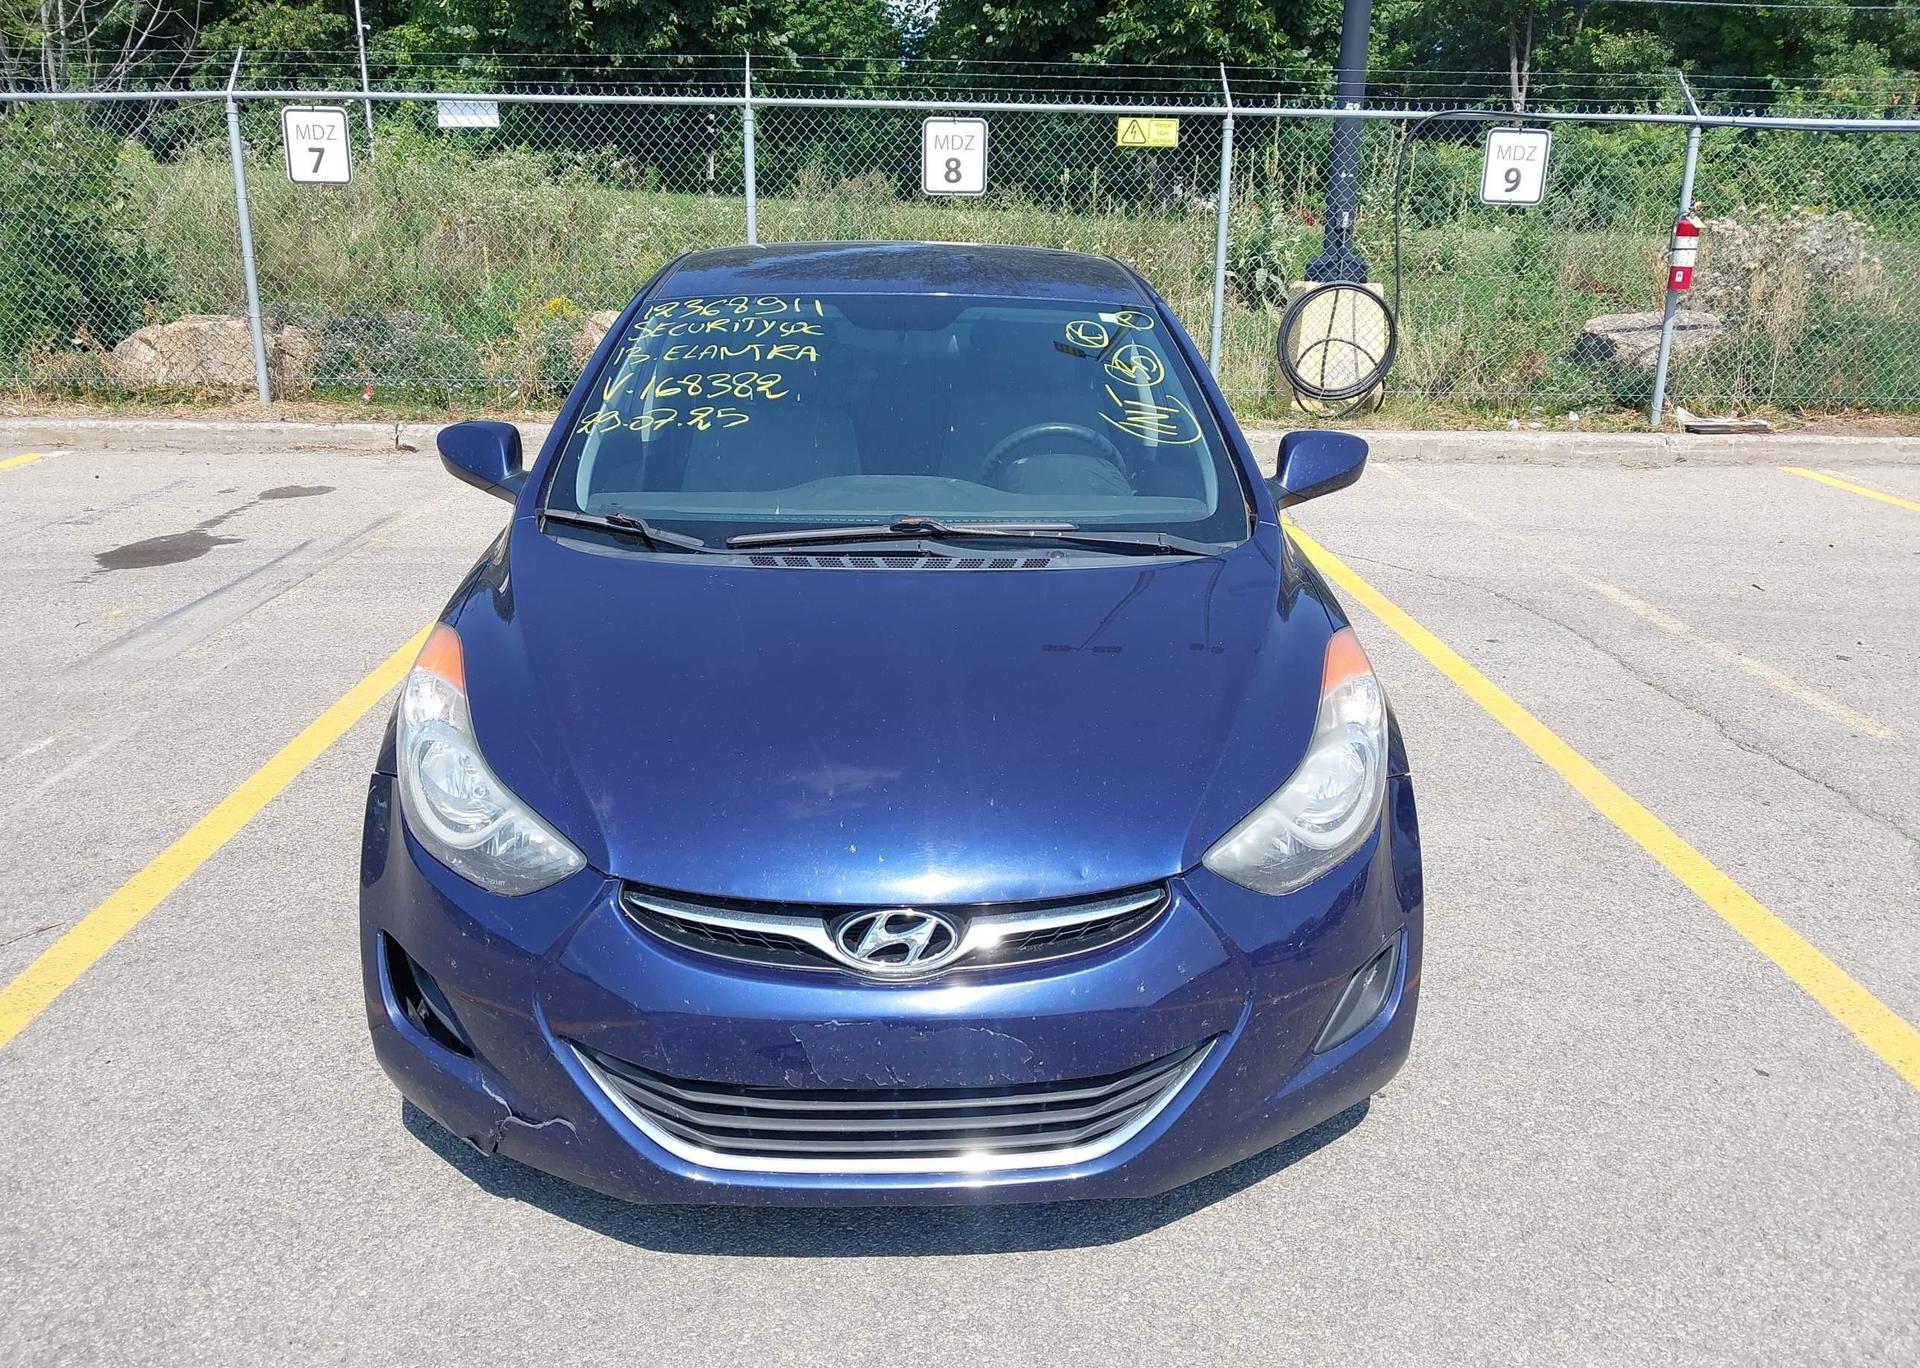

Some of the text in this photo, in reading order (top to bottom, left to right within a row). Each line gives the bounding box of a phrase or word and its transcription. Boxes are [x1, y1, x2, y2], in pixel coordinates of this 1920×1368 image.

[295, 124, 337, 141] MDZ
[934, 134, 975, 151] MDZ
[308, 147, 325, 174] 7
[1496, 144, 1538, 162] MDZ
[944, 157, 963, 184] 8
[1504, 167, 1522, 193] 9
[644, 296, 825, 321] 12368911
